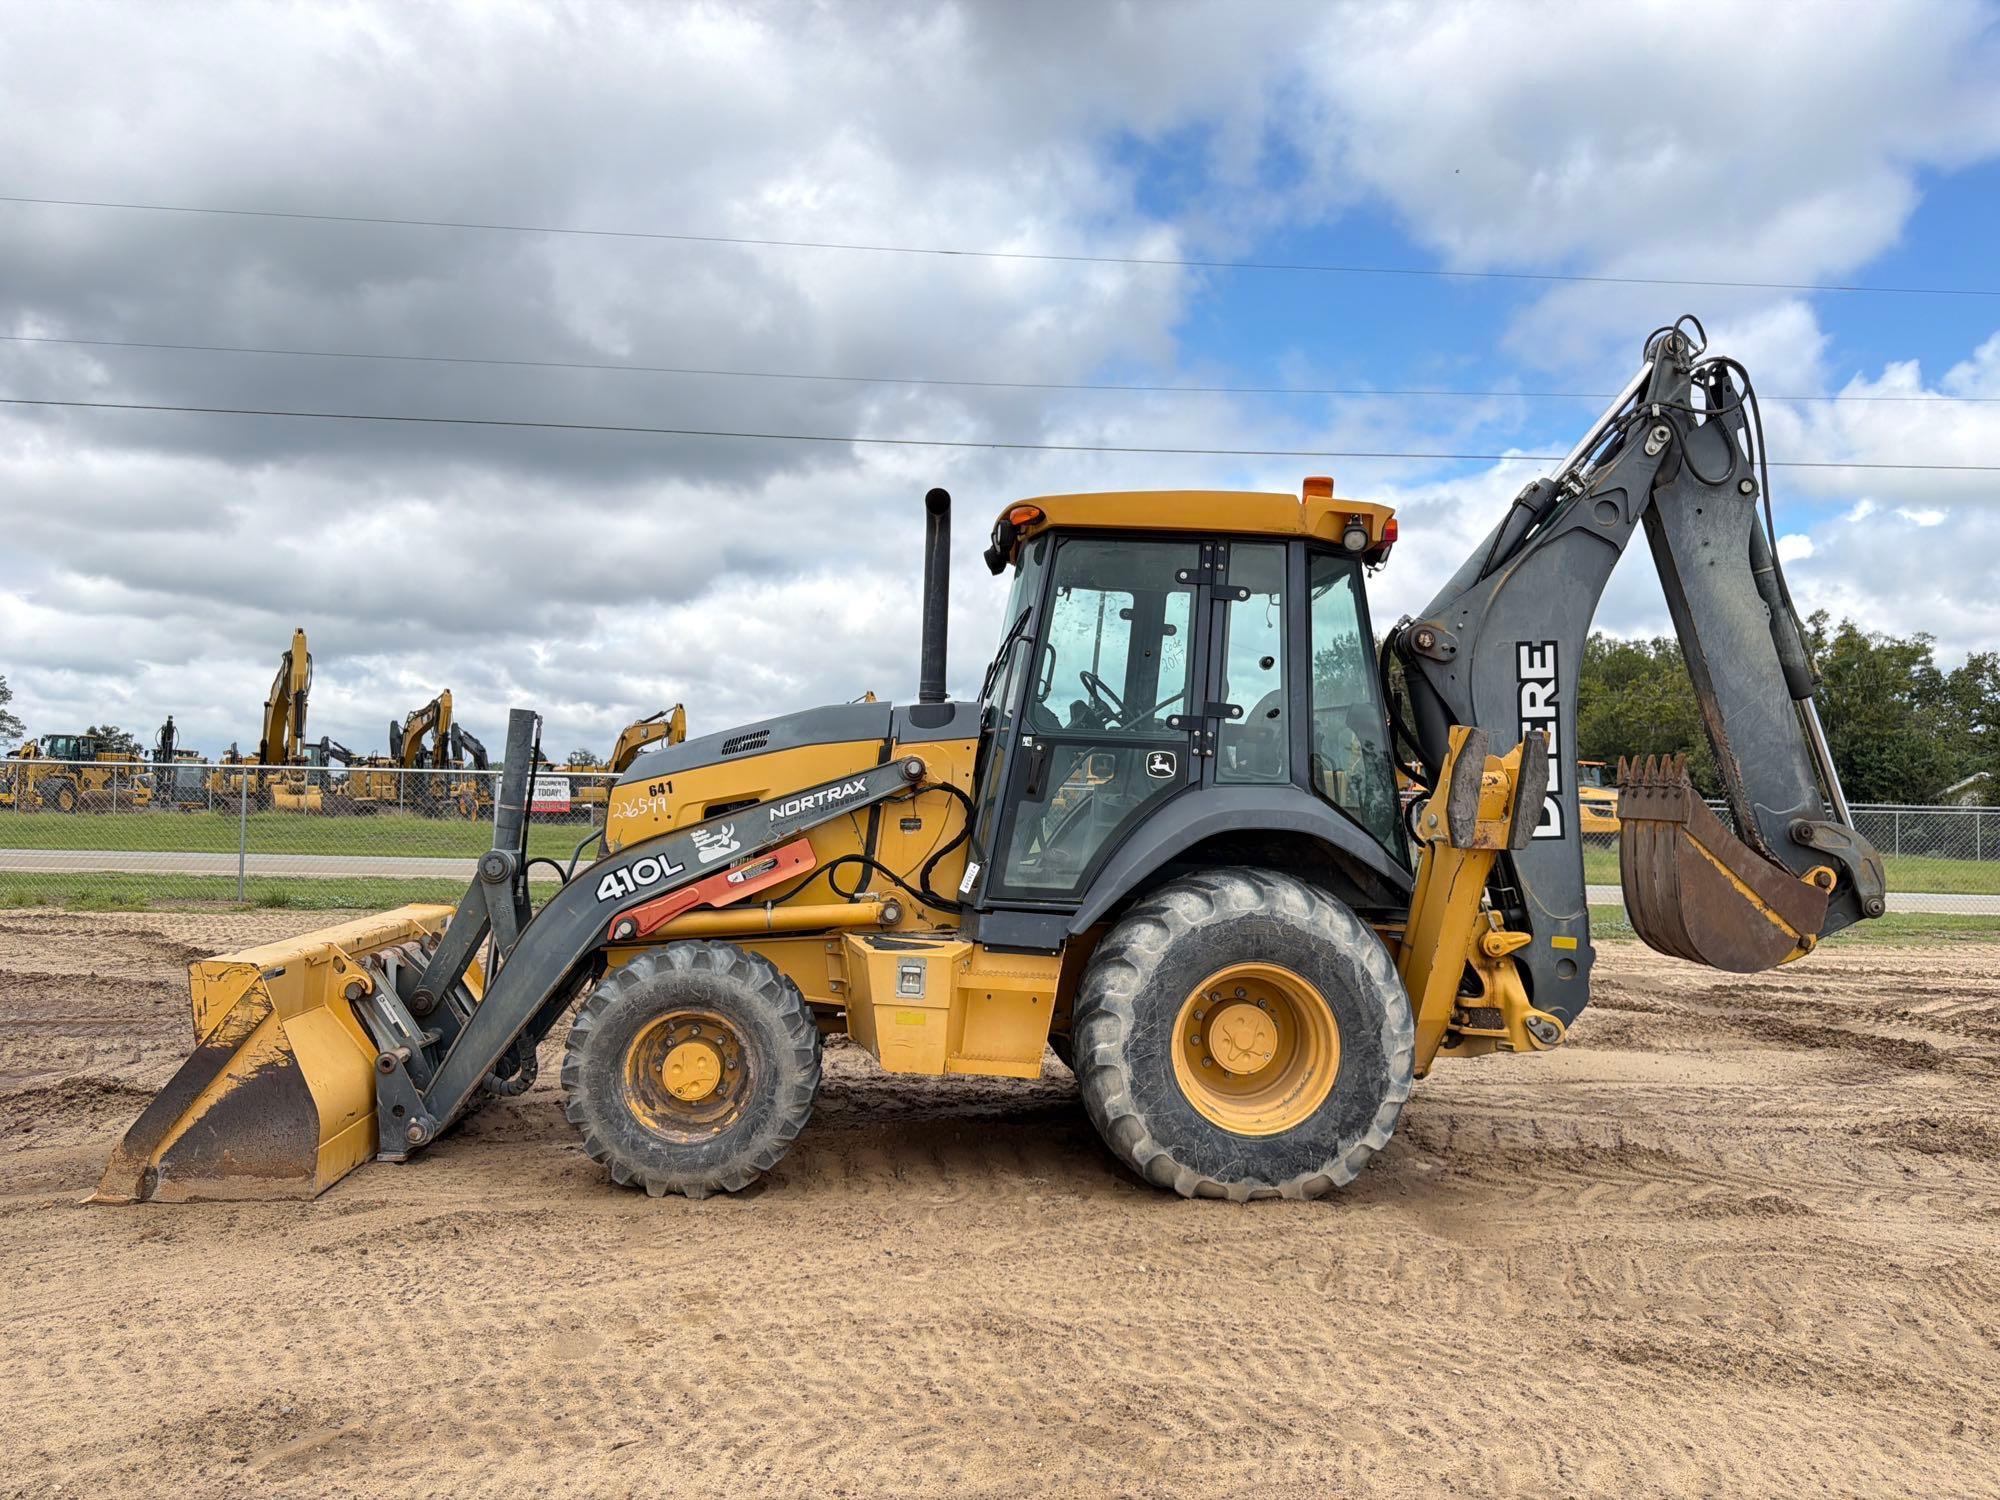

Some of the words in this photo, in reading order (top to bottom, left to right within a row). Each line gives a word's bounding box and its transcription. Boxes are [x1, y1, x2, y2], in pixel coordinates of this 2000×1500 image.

[538, 788, 561, 796] TODAY!
[648, 780, 673, 797] 641
[769, 777, 866, 821] NORTRAX
[612, 797, 667, 819] 226549
[595, 853, 685, 901] 410L
